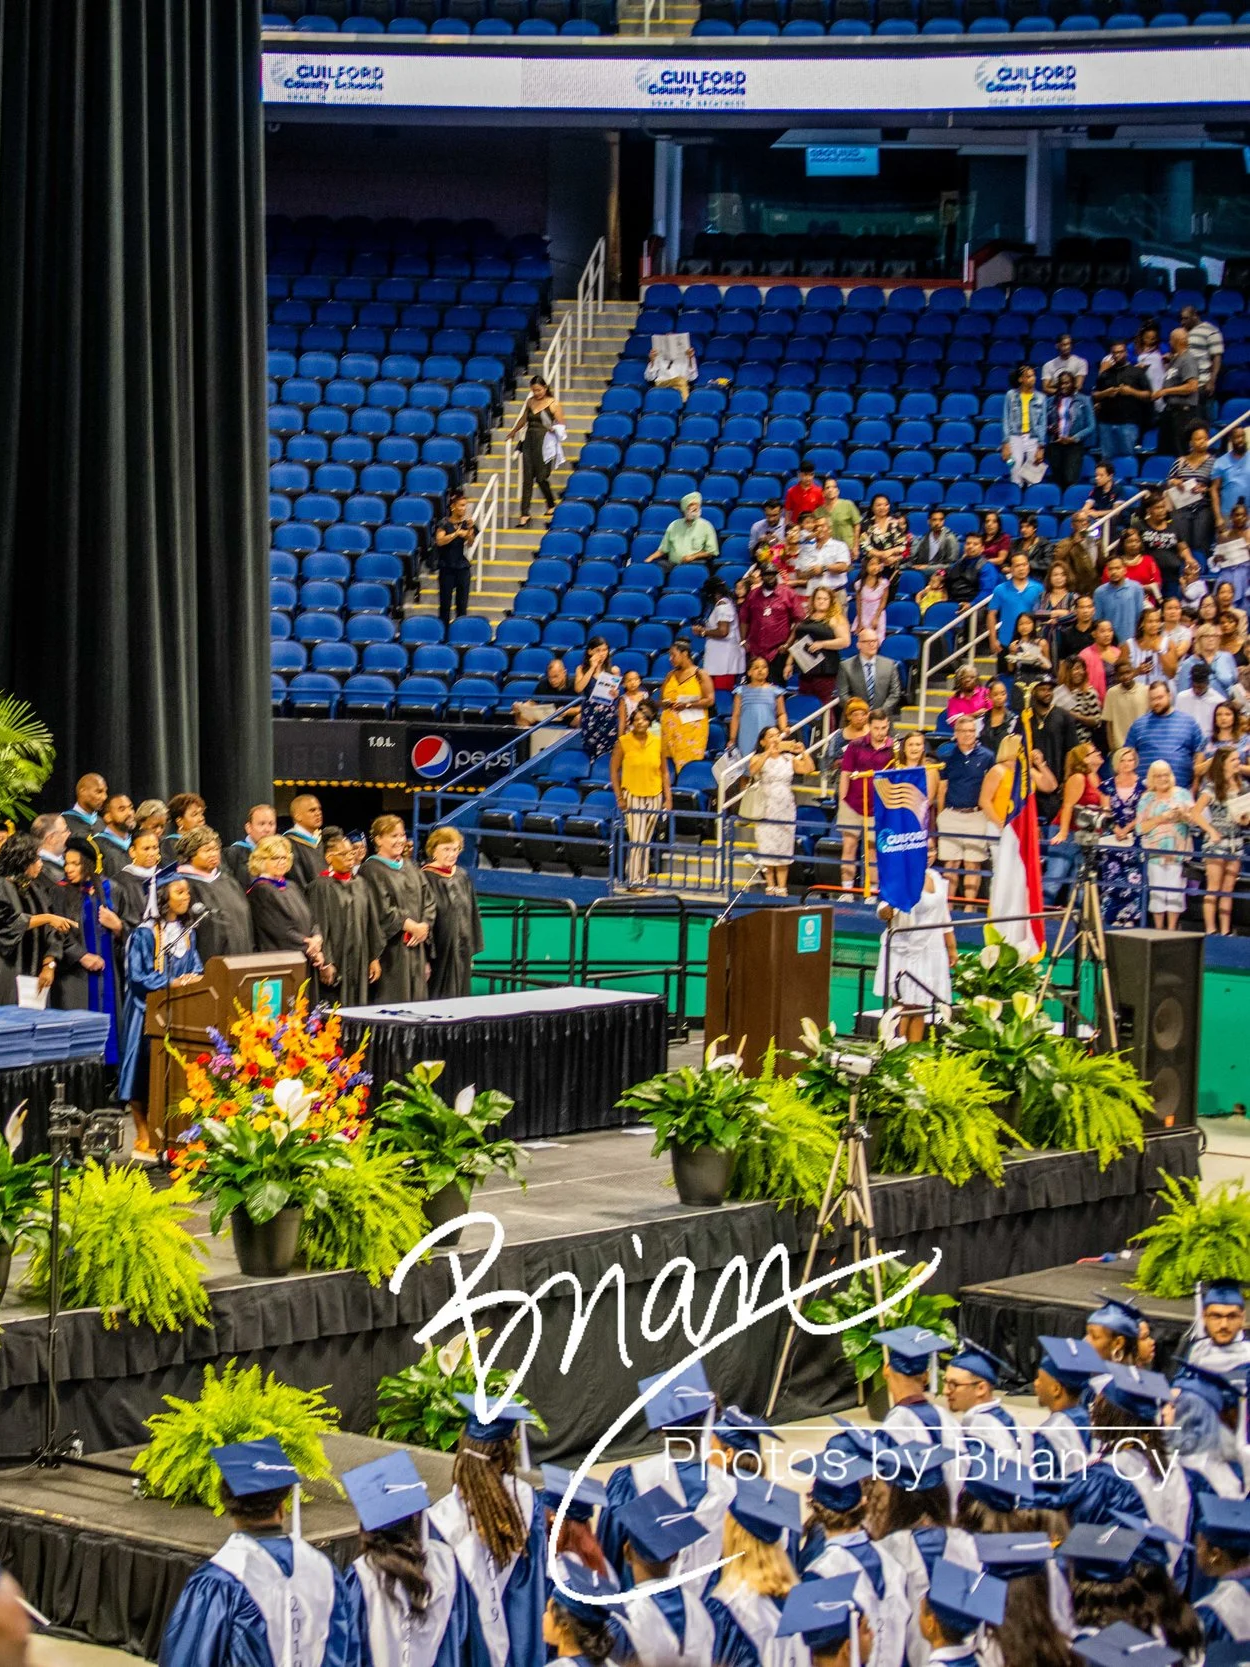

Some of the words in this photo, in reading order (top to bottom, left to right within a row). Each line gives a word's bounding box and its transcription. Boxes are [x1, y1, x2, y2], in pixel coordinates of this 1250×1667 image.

[296, 64, 384, 80] GUILFORD
[661, 70, 747, 86] GUILFORD
[997, 65, 1077, 81] GUILFORD
[283, 78, 330, 91] County
[334, 79, 383, 91] Schools
[647, 84, 694, 97] County
[697, 83, 746, 96] Schools
[985, 81, 1027, 94] County
[1031, 80, 1076, 92] Schools
[454, 749, 519, 771] pepsi
